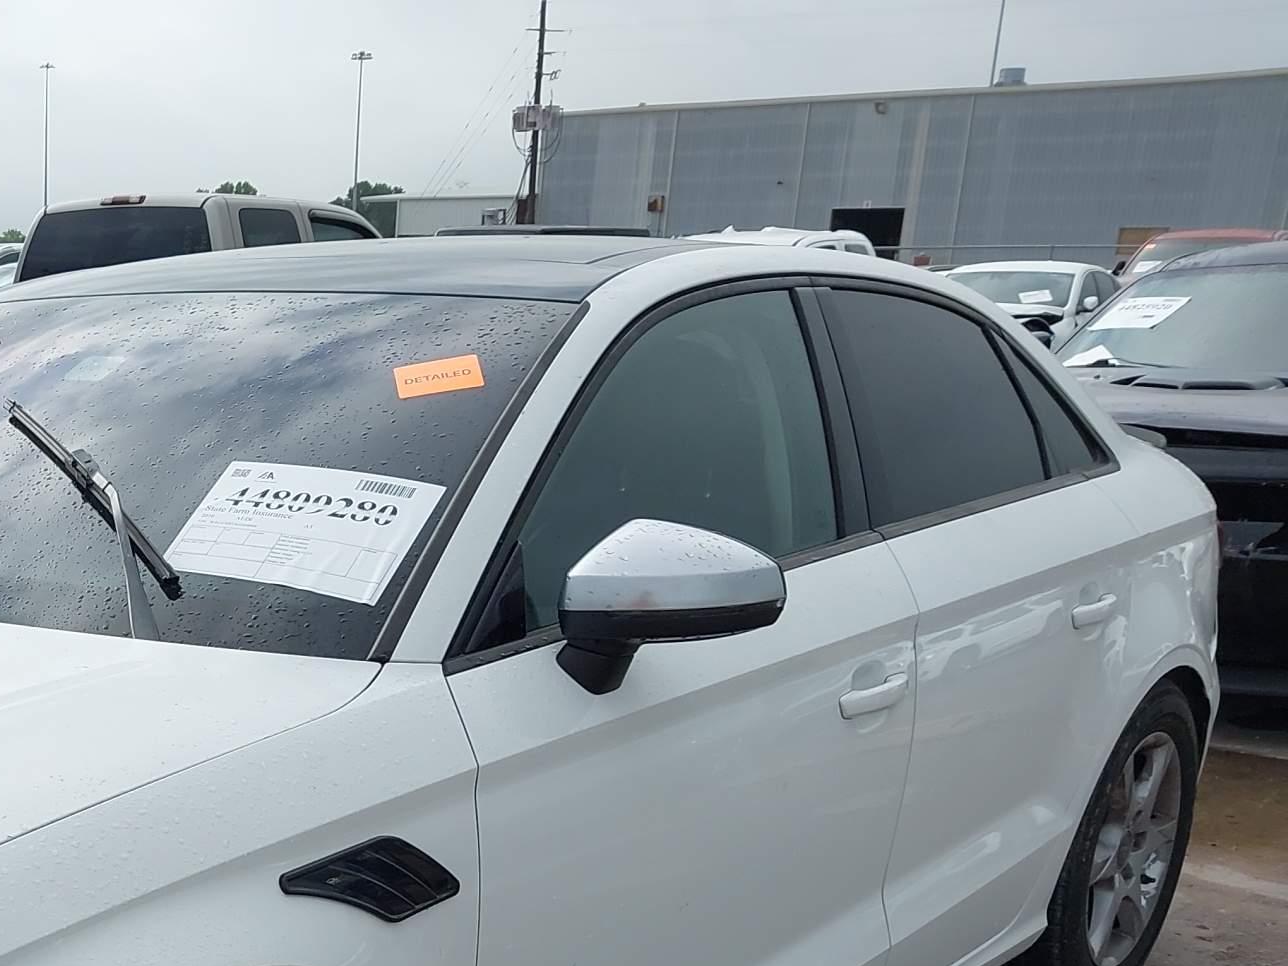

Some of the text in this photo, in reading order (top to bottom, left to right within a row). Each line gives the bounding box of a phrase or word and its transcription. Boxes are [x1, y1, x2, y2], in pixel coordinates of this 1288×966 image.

[404, 368, 472, 385] DETAILED
[204, 504, 227, 513] State
[228, 507, 251, 515] Farm
[252, 508, 294, 520] Insurance
[225, 487, 399, 526] 44809280
